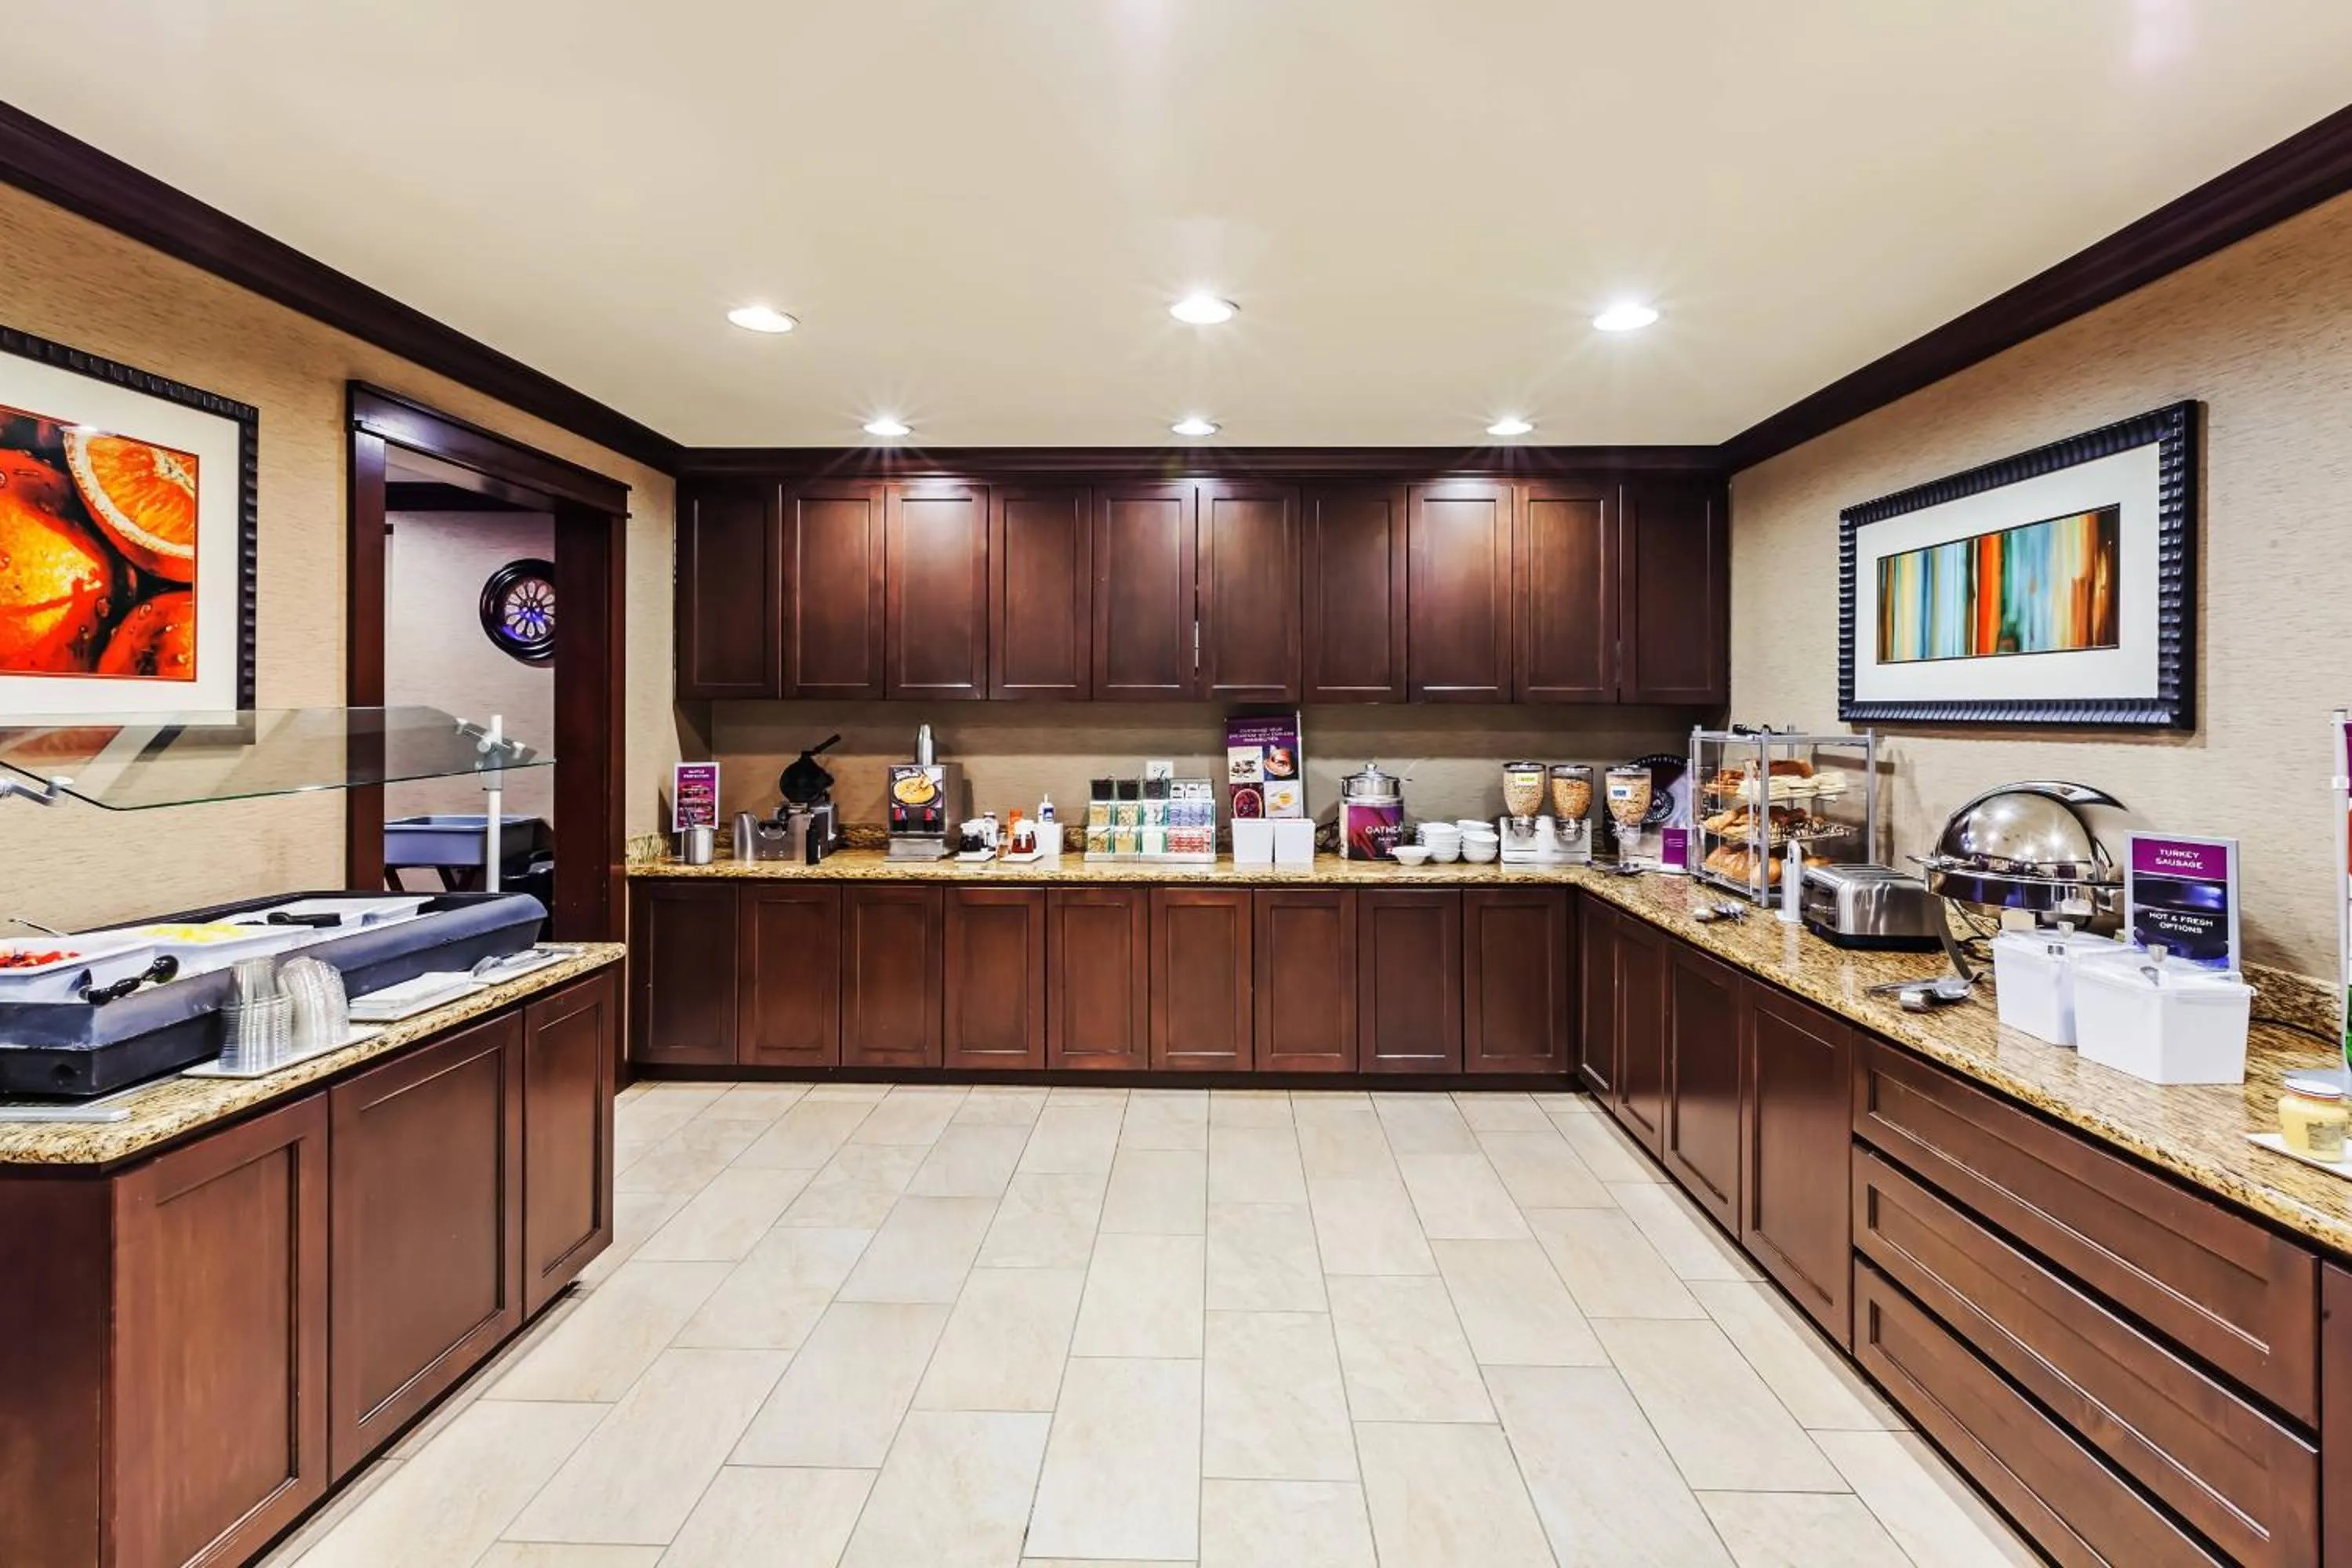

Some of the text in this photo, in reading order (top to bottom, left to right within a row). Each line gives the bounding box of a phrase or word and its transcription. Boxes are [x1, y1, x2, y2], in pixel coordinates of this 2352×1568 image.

[1365, 826, 1403, 834] OATMEA
[2159, 849, 2200, 859] TURKEY
[2155, 857, 2204, 869] SAUSAGE
[2149, 912, 2169, 920] HOT
[2180, 916, 2213, 927] FRESH
[2158, 921, 2203, 934] OPTIONS
